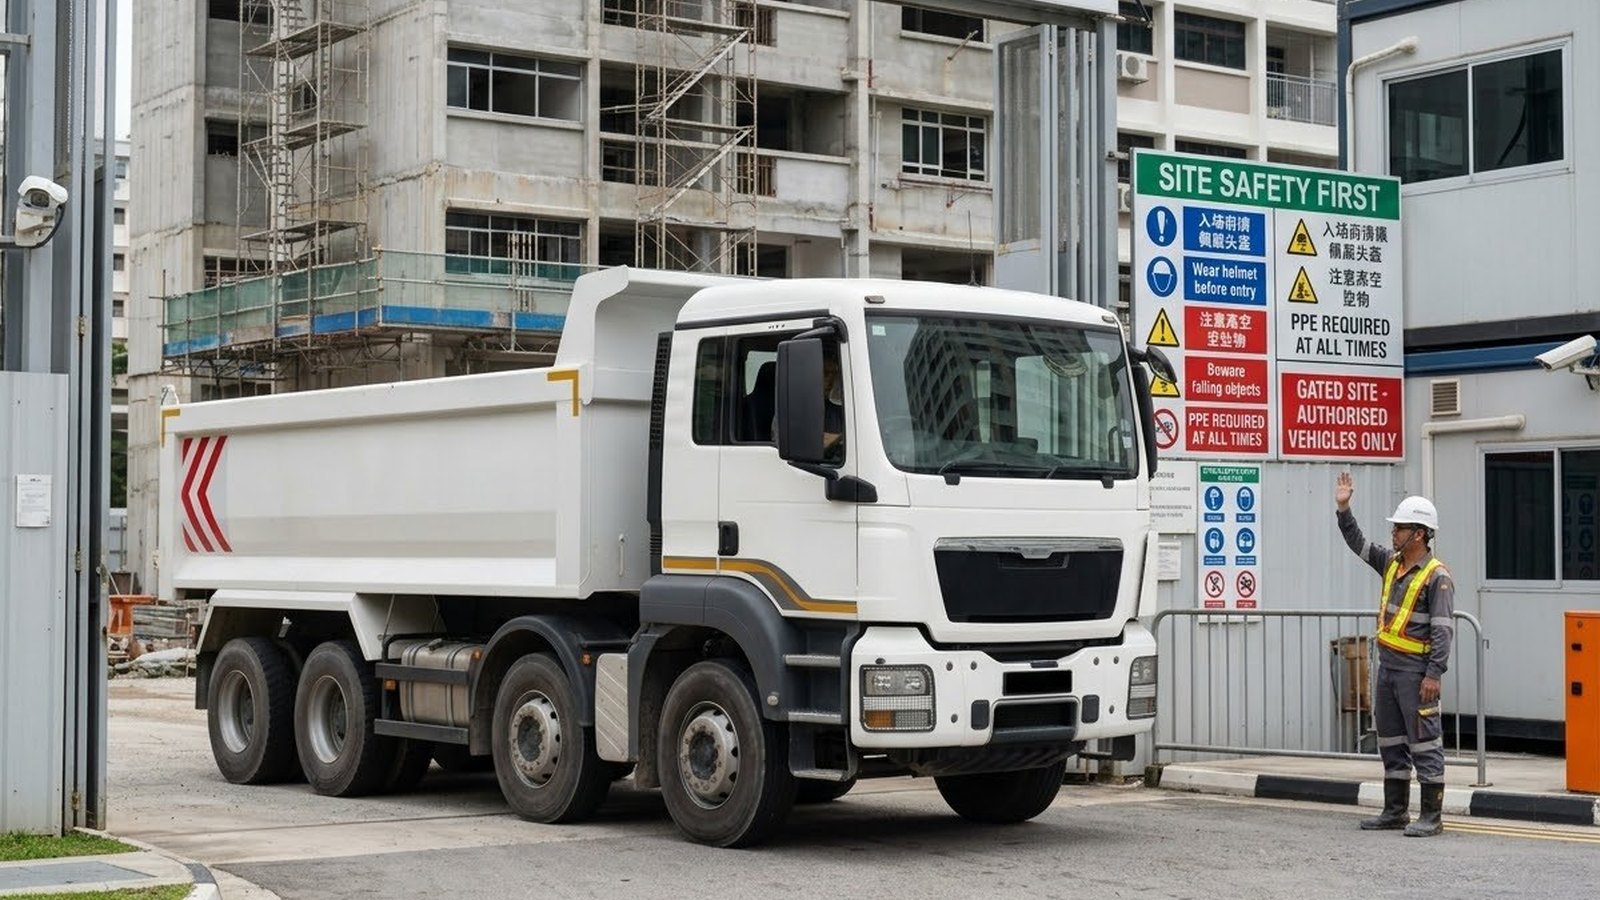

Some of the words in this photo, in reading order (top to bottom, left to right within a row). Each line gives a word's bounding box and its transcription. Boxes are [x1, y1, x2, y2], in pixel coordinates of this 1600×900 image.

[1158, 162, 1213, 195] SITE
[1219, 168, 1311, 205] SAFETY
[1317, 179, 1381, 212] FIRST
[1192, 262, 1220, 277] Wear
[1222, 264, 1258, 280] helmet
[1194, 280, 1227, 296] before
[1291, 313, 1318, 332] PPE
[1322, 315, 1390, 336] REQUIRED
[1296, 337, 1313, 354] AT
[1316, 338, 1342, 356] ALL
[1345, 339, 1387, 359] TIMES
[1225, 382, 1261, 398] objects
[1297, 379, 1343, 400] GATED
[1347, 382, 1378, 402] SITE
[1188, 412, 1209, 427] PPE
[1297, 404, 1388, 426] AUTHORISED
[1208, 431, 1227, 446] ALL
[1230, 432, 1262, 447] TIMES
[1288, 429, 1357, 450] VEHICLES
[1361, 431, 1397, 452] ONLY
